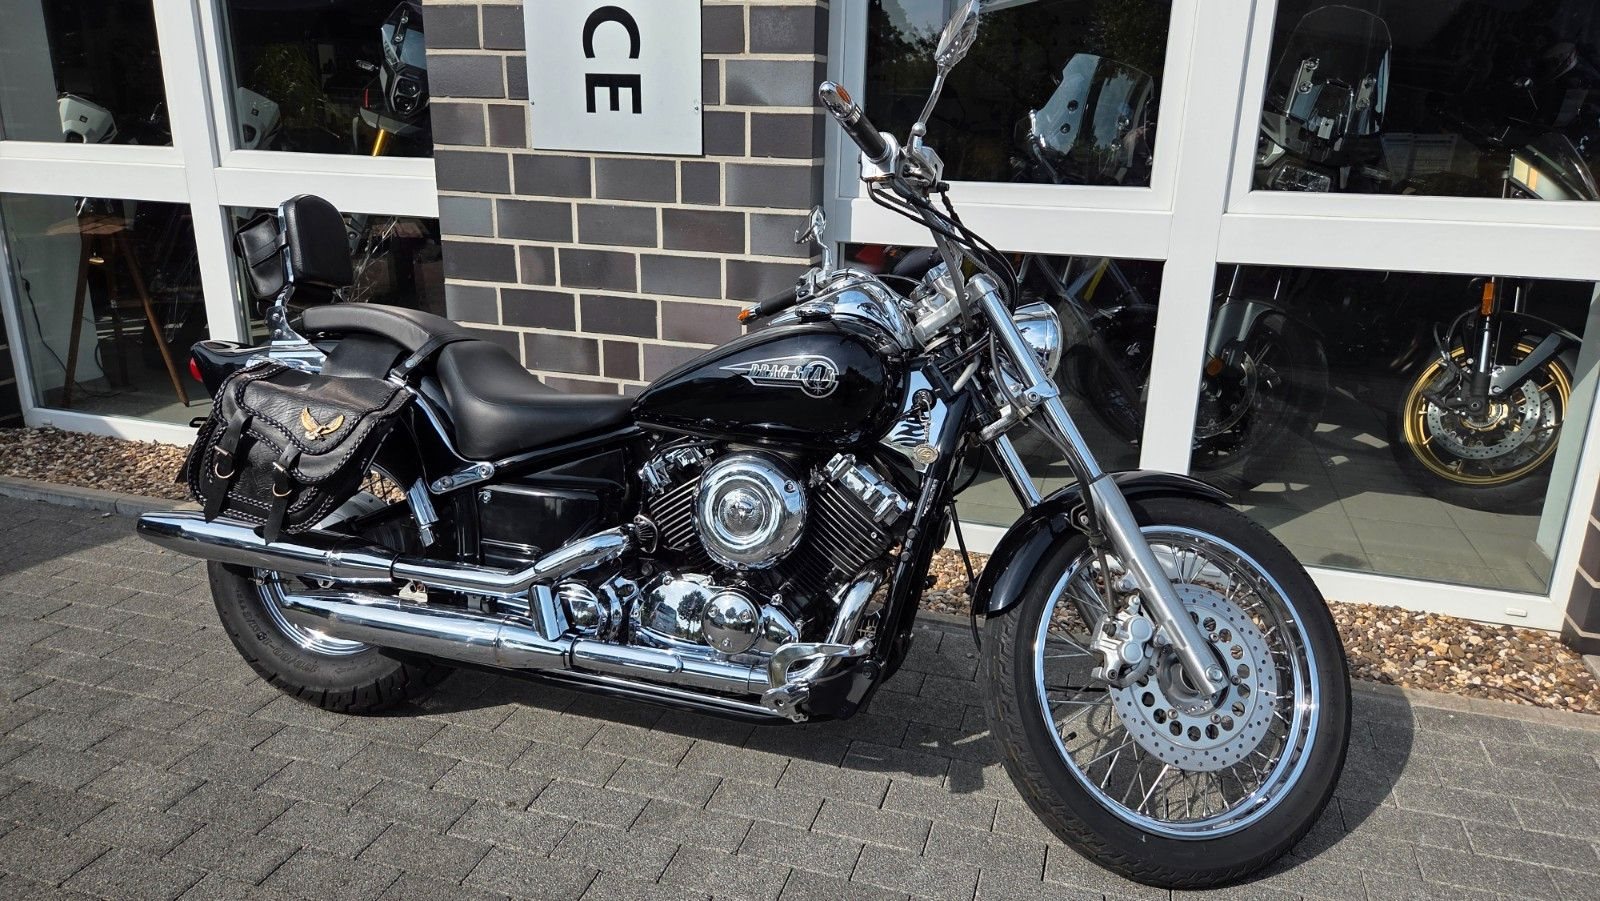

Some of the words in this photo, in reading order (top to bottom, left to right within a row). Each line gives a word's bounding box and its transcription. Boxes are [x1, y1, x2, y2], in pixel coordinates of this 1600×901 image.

[582, 5, 642, 114] CE
[748, 363, 789, 378] DRAG
[791, 365, 835, 381] STAR
